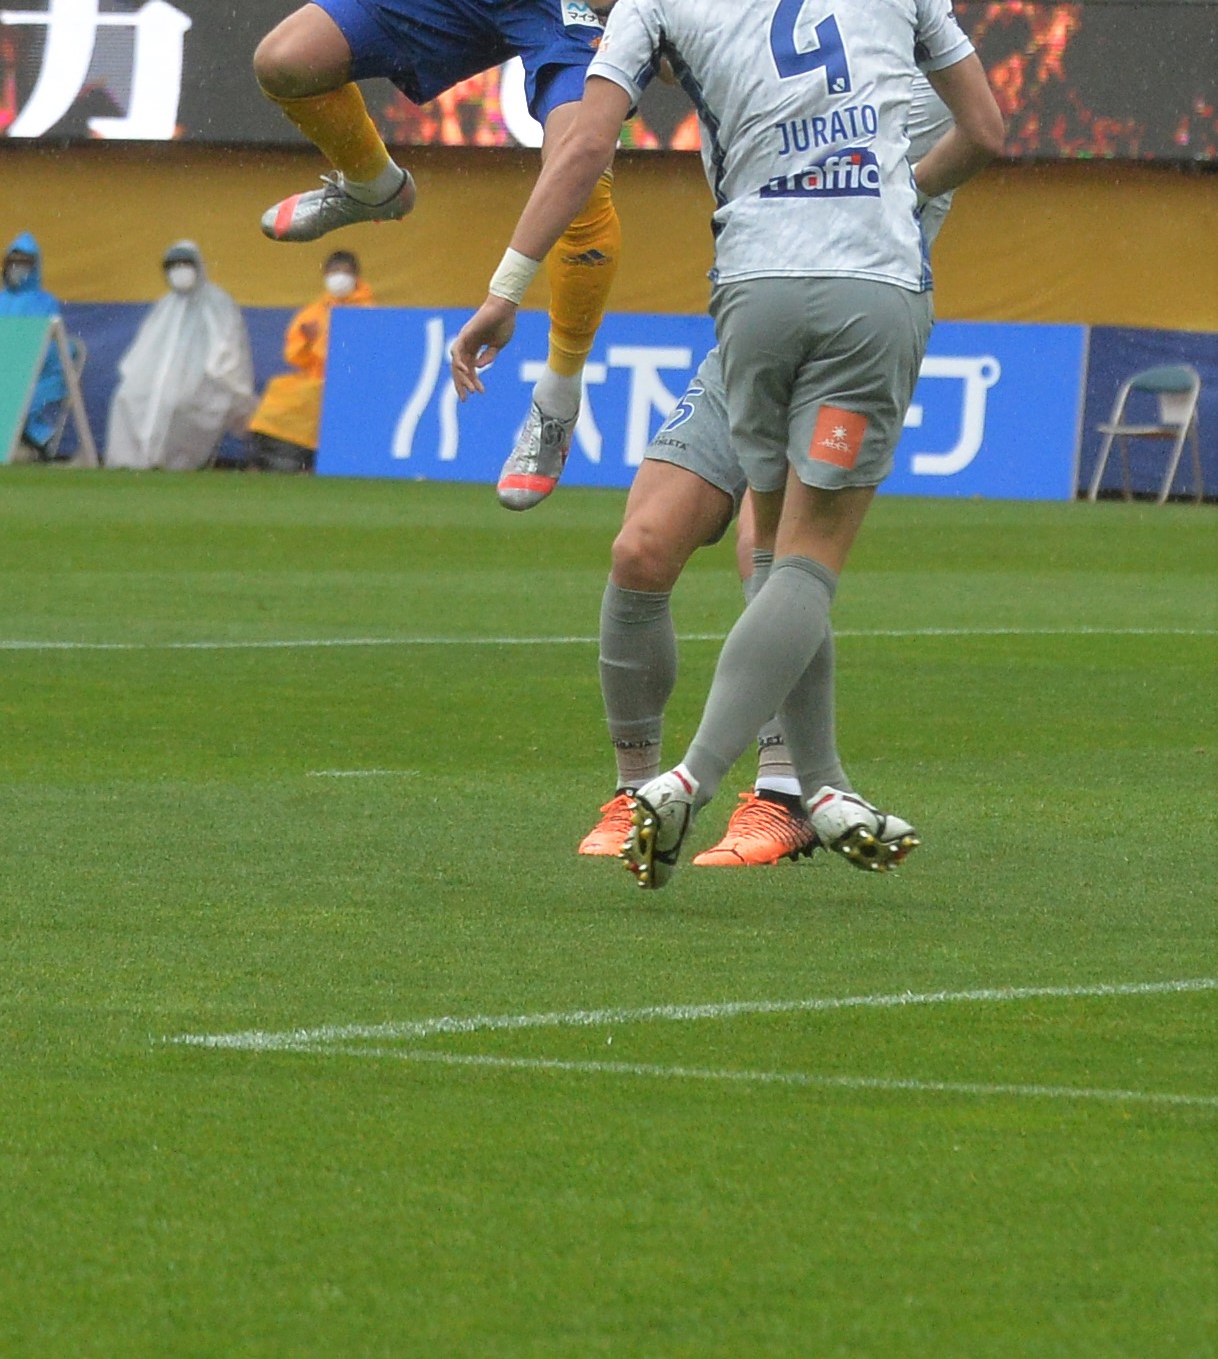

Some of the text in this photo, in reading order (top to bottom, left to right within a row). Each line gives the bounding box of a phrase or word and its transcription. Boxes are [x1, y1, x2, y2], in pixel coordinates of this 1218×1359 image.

[567, 11, 598, 23] マイナ
[776, 104, 878, 156] JURATO
[660, 387, 706, 433] 5
